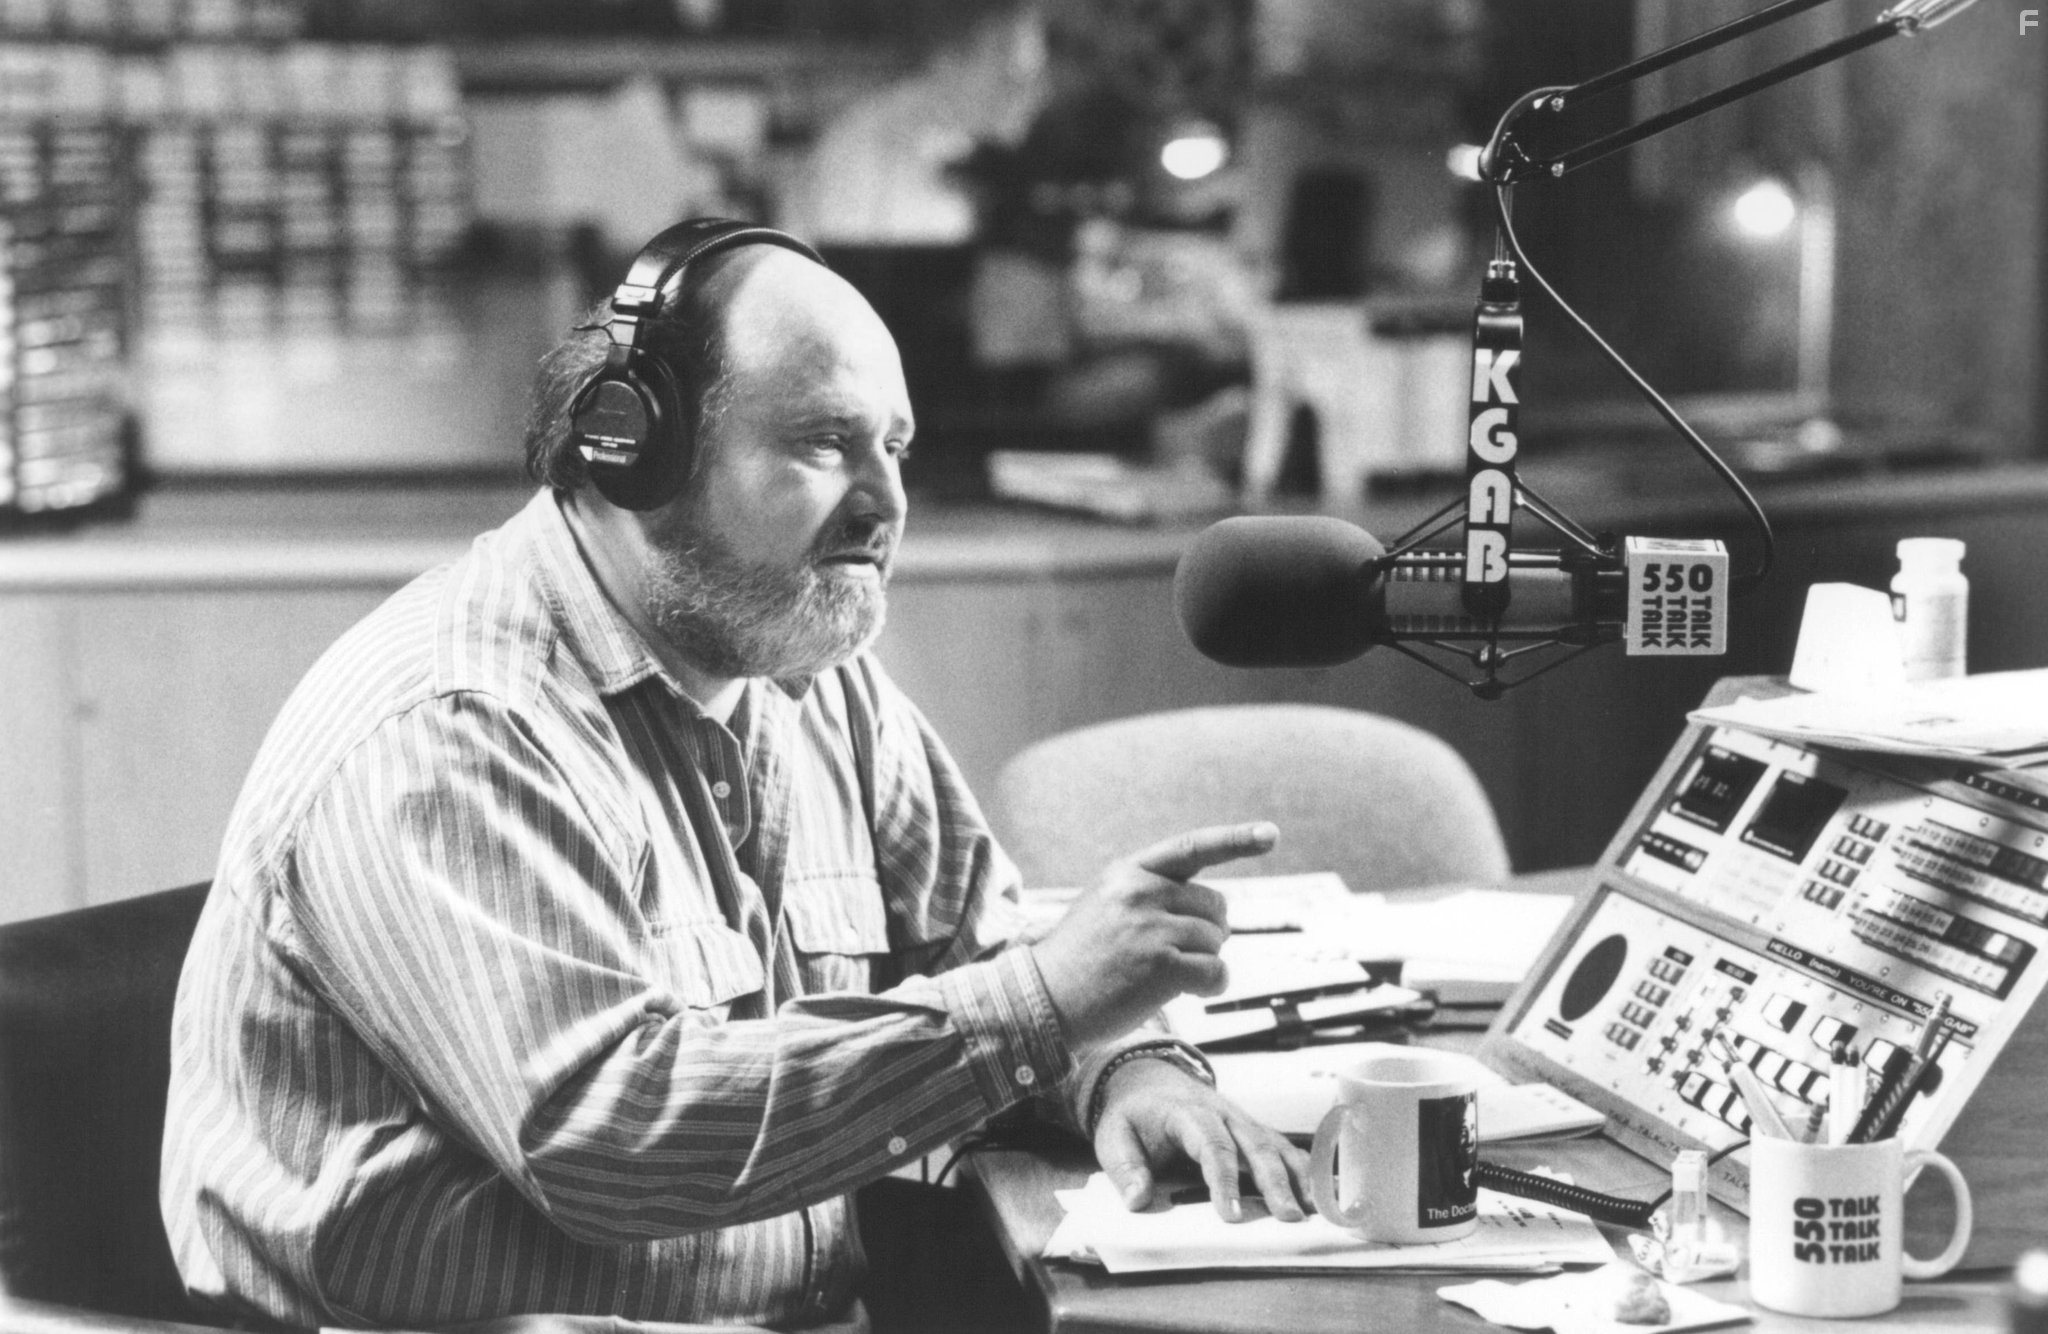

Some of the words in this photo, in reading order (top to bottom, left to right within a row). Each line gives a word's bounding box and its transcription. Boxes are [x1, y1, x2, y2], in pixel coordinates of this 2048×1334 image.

[1465, 348, 1521, 583] KGAB
[1642, 563, 1714, 593] 550
[1641, 595, 1664, 649] TALK
[1665, 595, 1688, 649] TALK
[1690, 595, 1713, 649] TALK
[1769, 940, 1803, 961] HELLO
[1850, 976, 1889, 999] YOU'RE
[1890, 993, 1909, 1008] ON
[1427, 1207, 1449, 1221] The
[1793, 1197, 1825, 1264] 550
[1828, 1195, 1880, 1218] TALK
[1828, 1218, 1880, 1241] TALK
[1828, 1241, 1880, 1264] TALK
